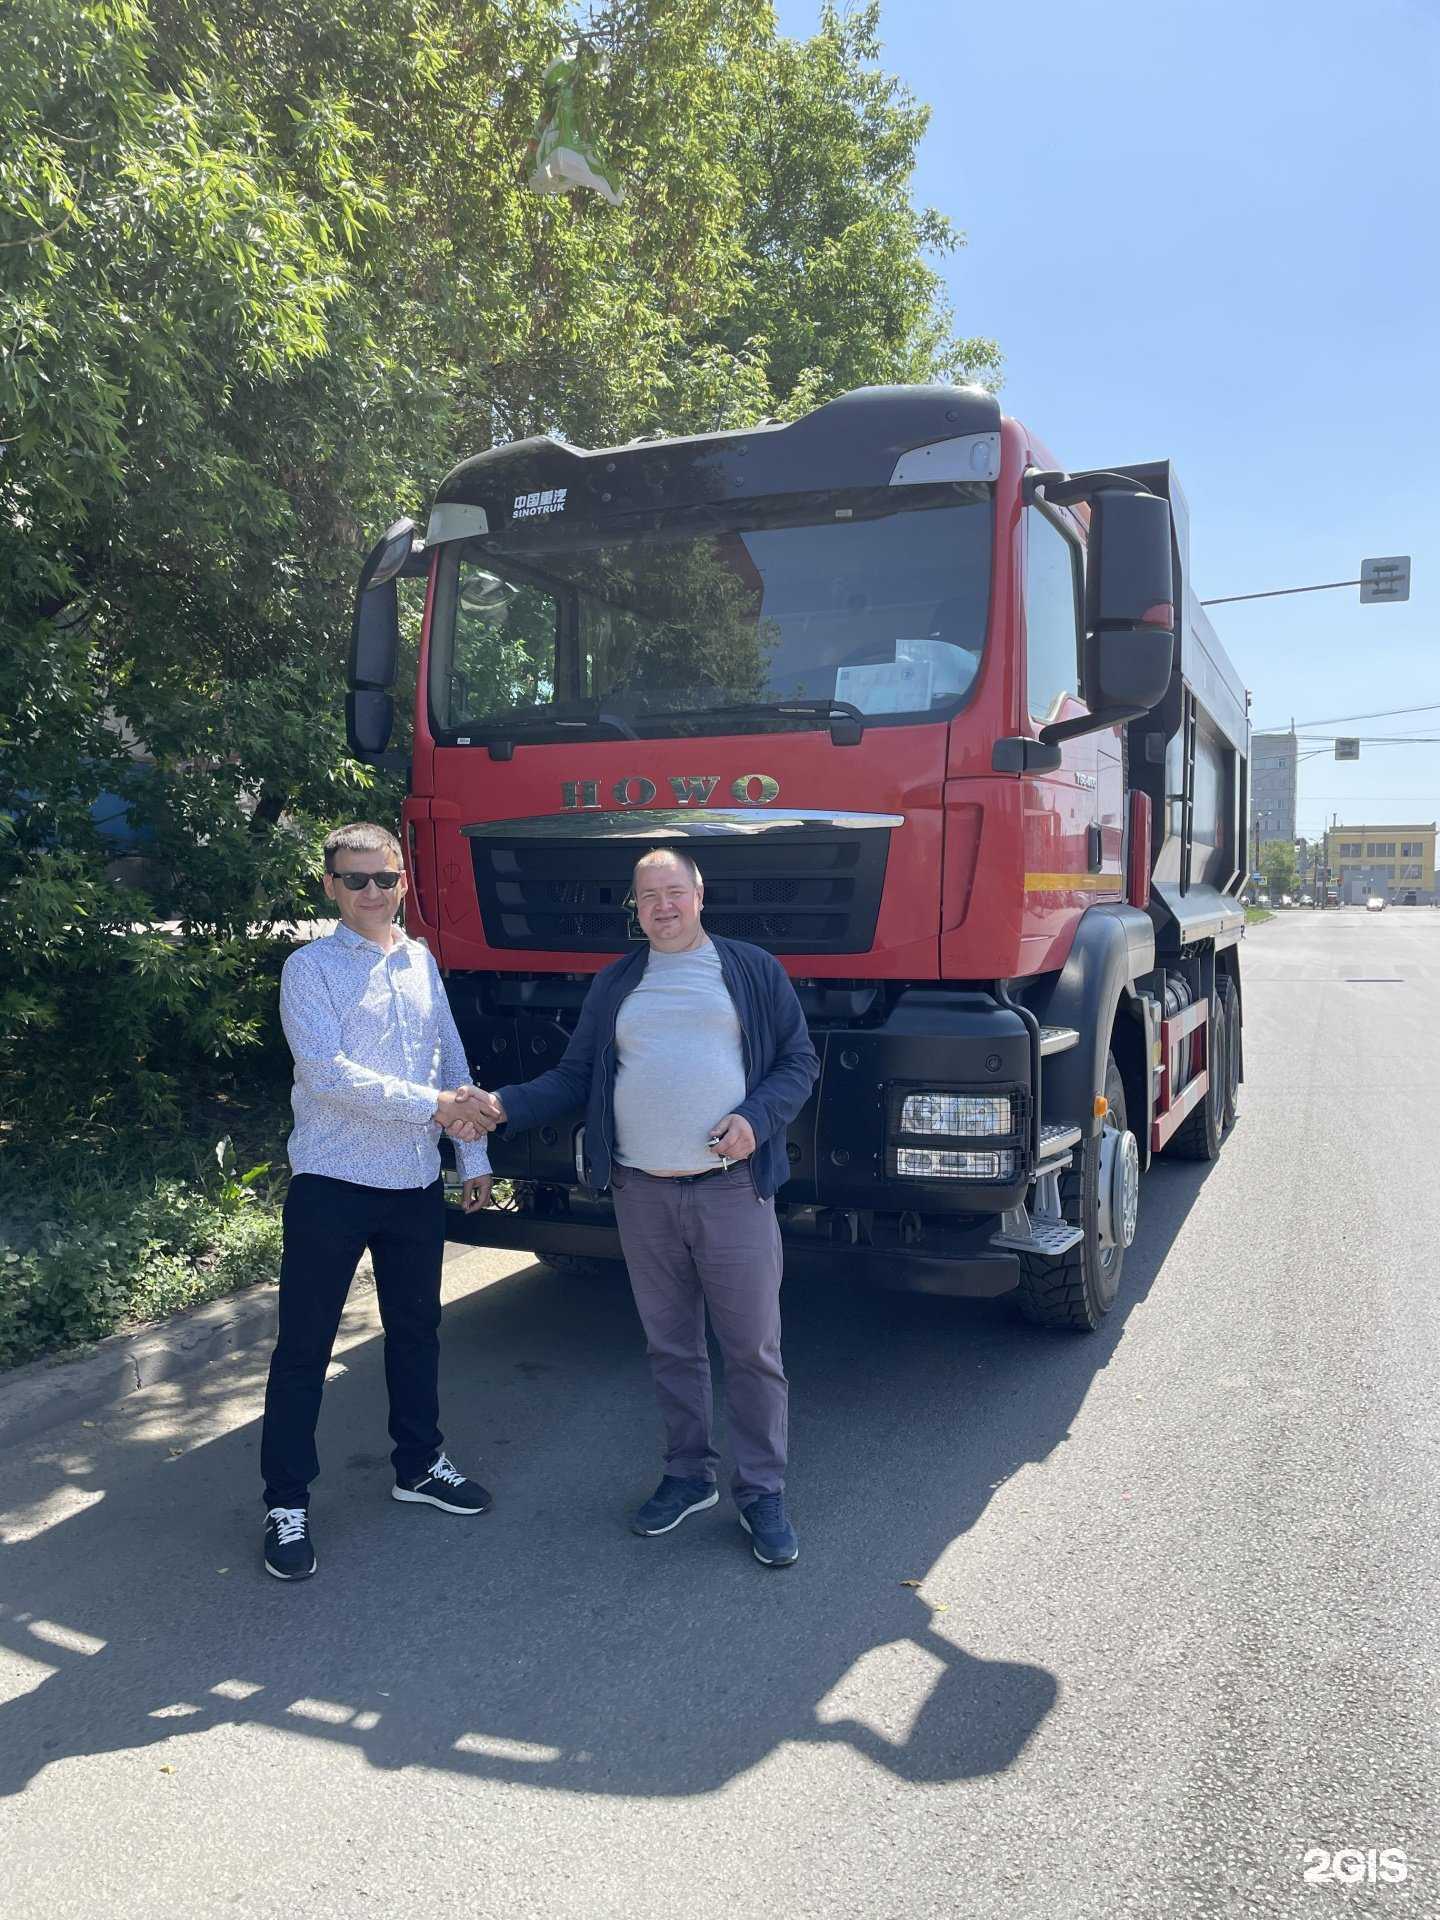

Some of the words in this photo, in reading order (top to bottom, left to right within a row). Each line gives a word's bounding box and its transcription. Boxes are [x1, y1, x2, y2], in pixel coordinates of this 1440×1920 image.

[514, 489, 567, 509] 中国重汽
[512, 503, 565, 519] SINOTRUK
[560, 774, 780, 809] HOWO
